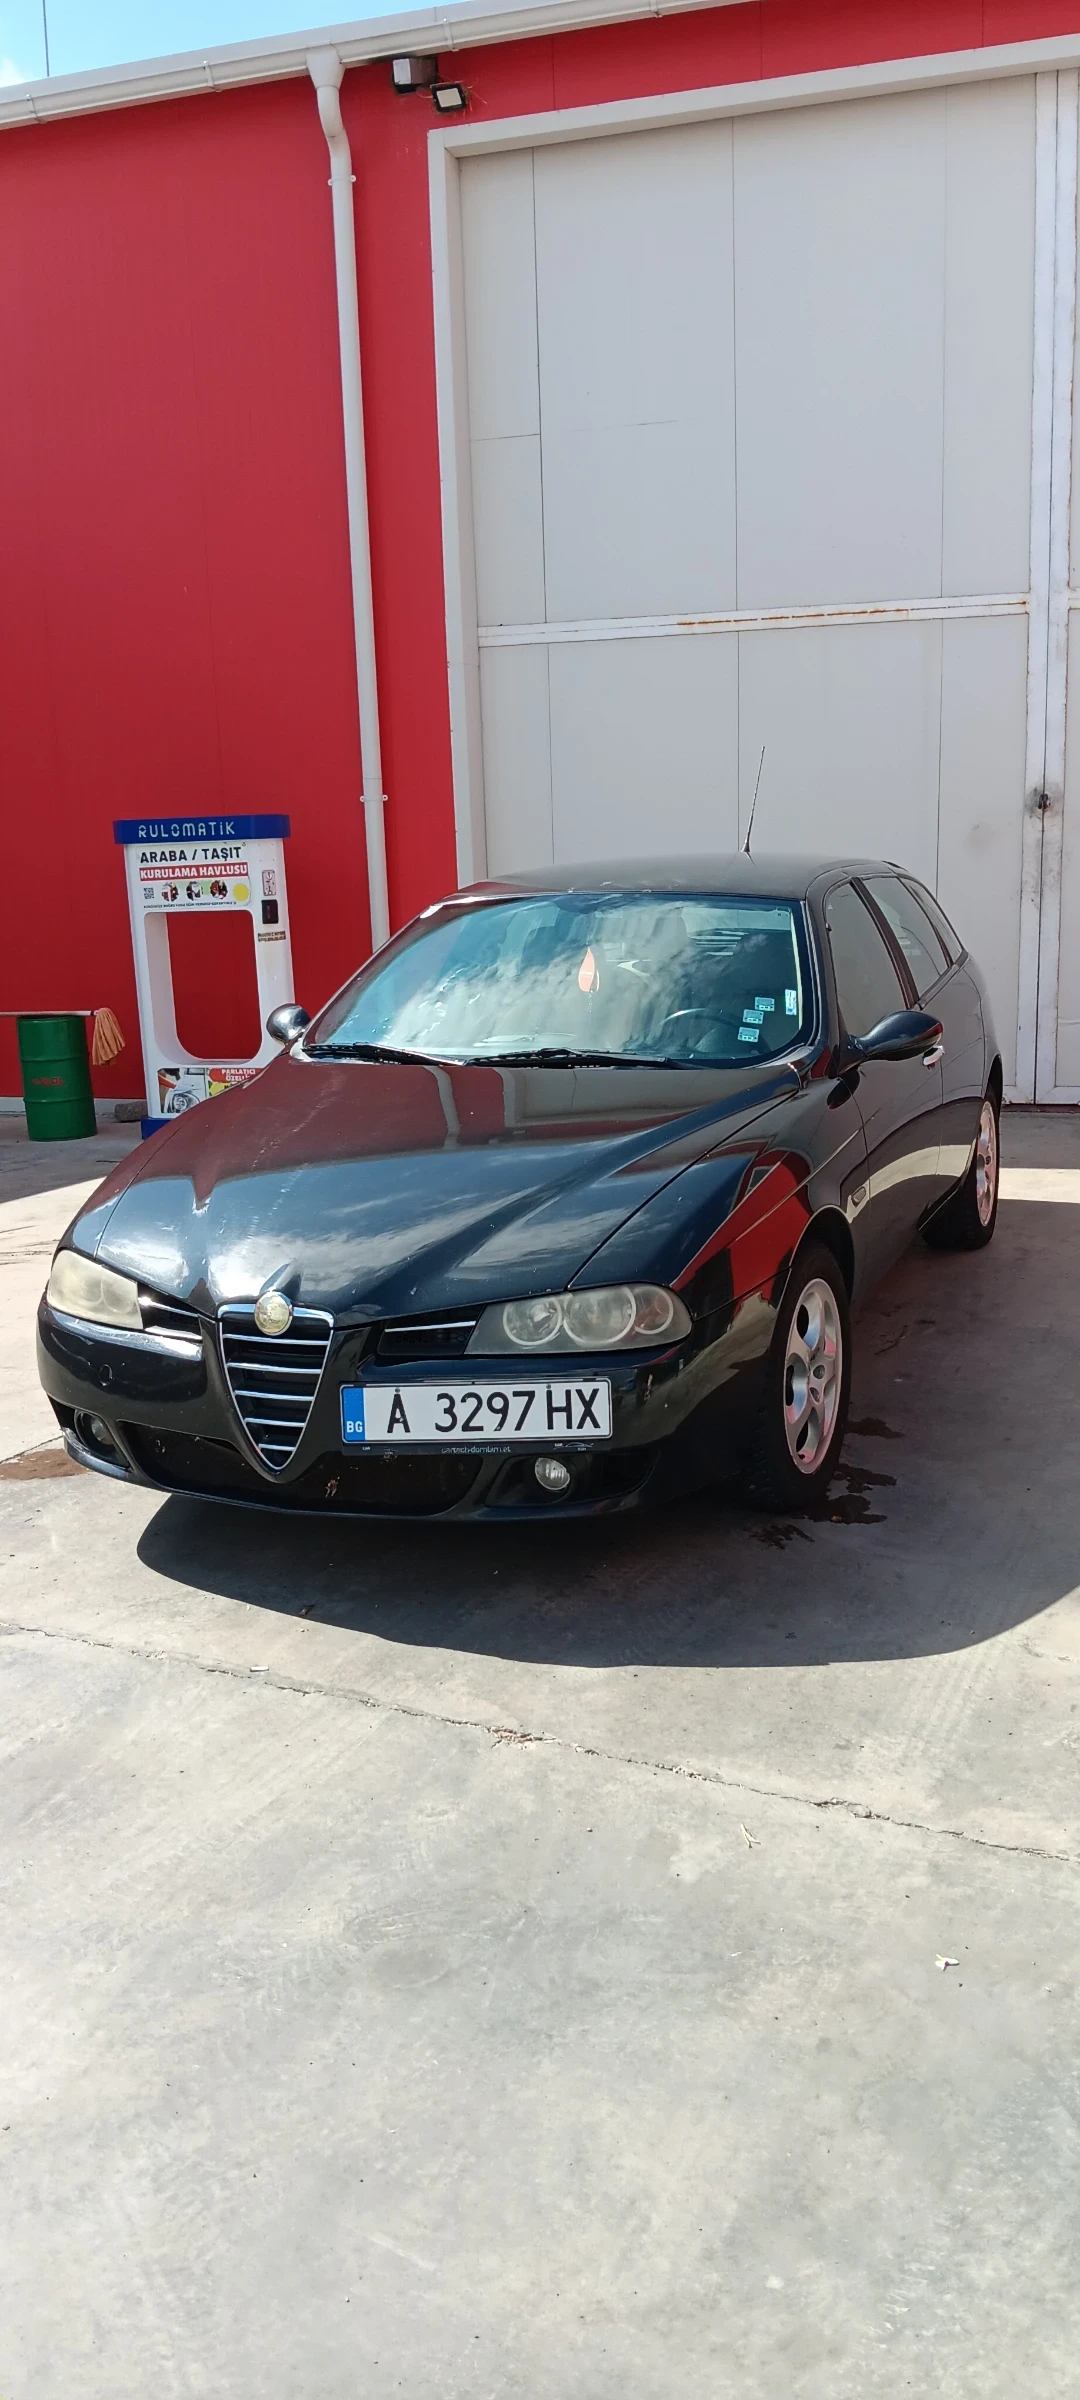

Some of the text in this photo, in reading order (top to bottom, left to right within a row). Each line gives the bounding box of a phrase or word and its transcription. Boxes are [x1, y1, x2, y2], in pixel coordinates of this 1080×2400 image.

[140, 849, 188, 864] ARABA
[201, 846, 242, 862] TAŞIT
[140, 864, 247, 880] KURULAMA HAVLUSU
[346, 1388, 601, 1434] BG A 3297 HX
